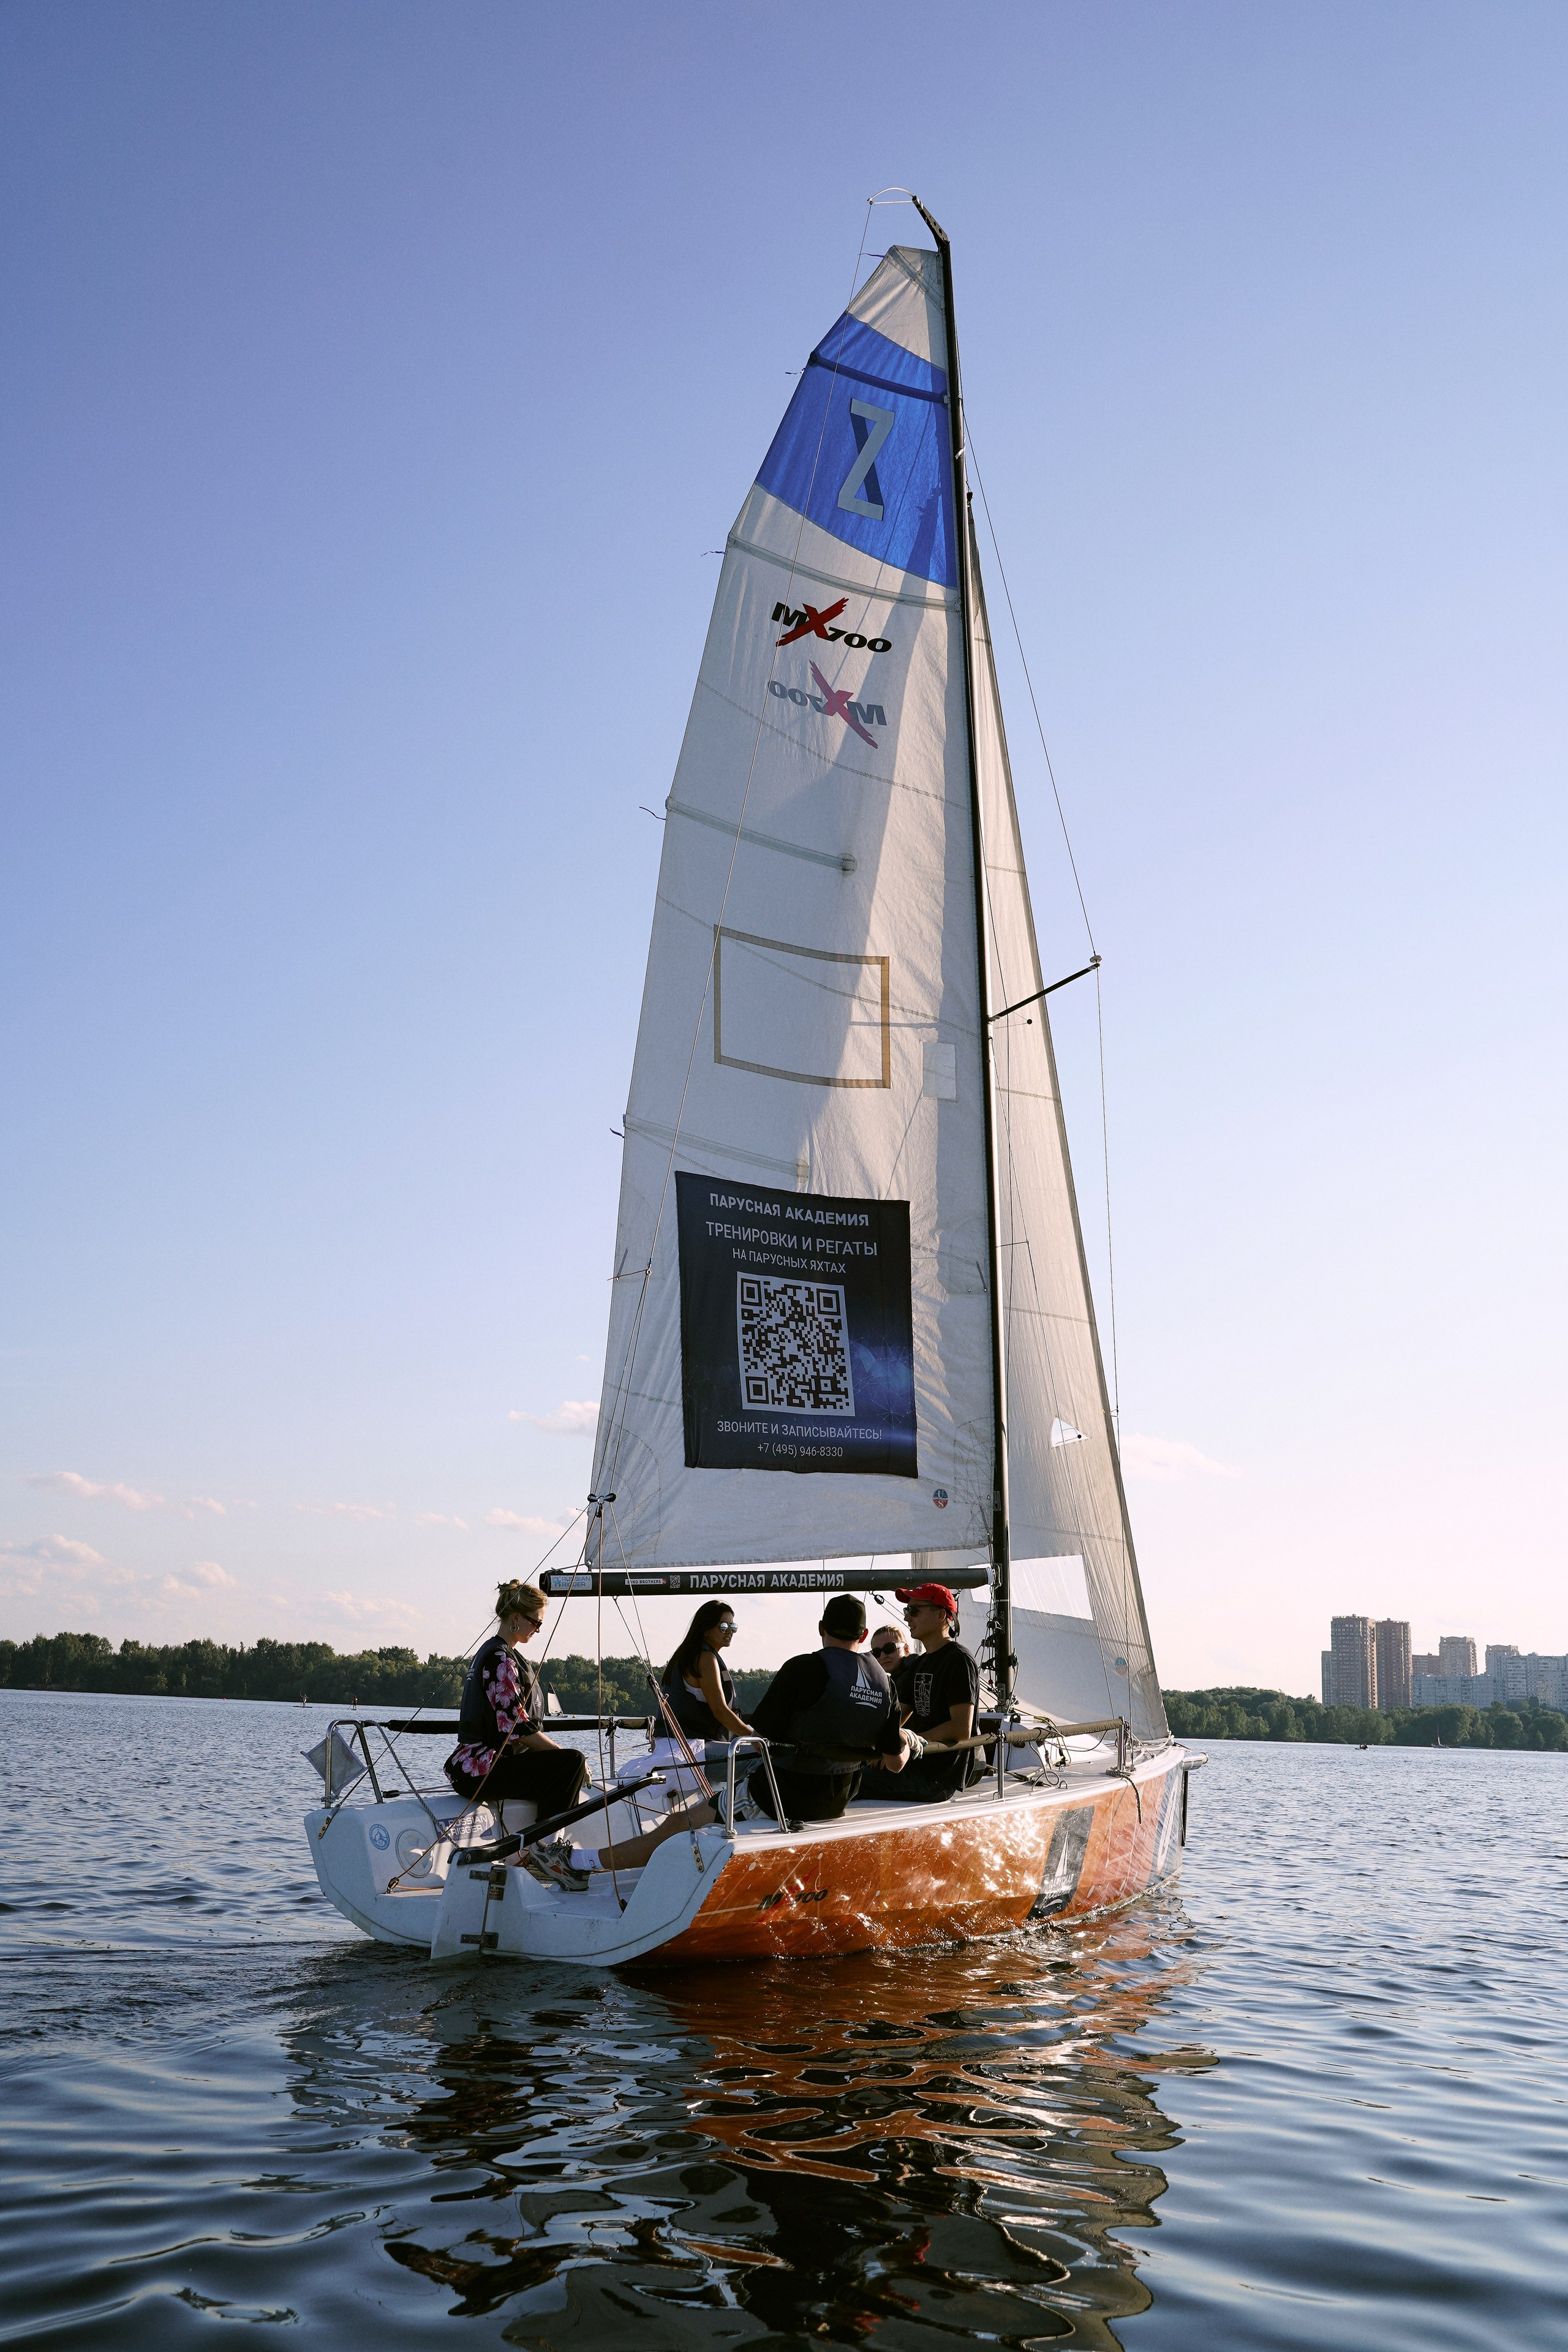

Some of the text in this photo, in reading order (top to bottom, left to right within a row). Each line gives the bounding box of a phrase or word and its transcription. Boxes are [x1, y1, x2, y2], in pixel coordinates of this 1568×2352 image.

[771, 597, 892, 653] MX700
[709, 1193, 869, 1226] ПАРУСНАЯ АКАДЕМИЯ
[706, 1221, 878, 1256] ТРЕНИРОВКИ И РЕГАТЫ
[733, 1248, 846, 1274] НА ПАРУСНЫХ ЯХТАХ
[717, 1420, 882, 1440] ЗВОНИТЕ И ЗАПИСЫВАЙТЕСЬ!
[757, 1442, 843, 1458] +7 (495) 946-8330
[690, 1574, 845, 1588] ПАРУСНАЯ АКАДЕМИЯ
[849, 1692, 882, 1704] АКАДЕМИЯ
[851, 1686, 882, 1698] ПАРУСНАЯ
[451, 1824, 483, 1836] RIGGER
